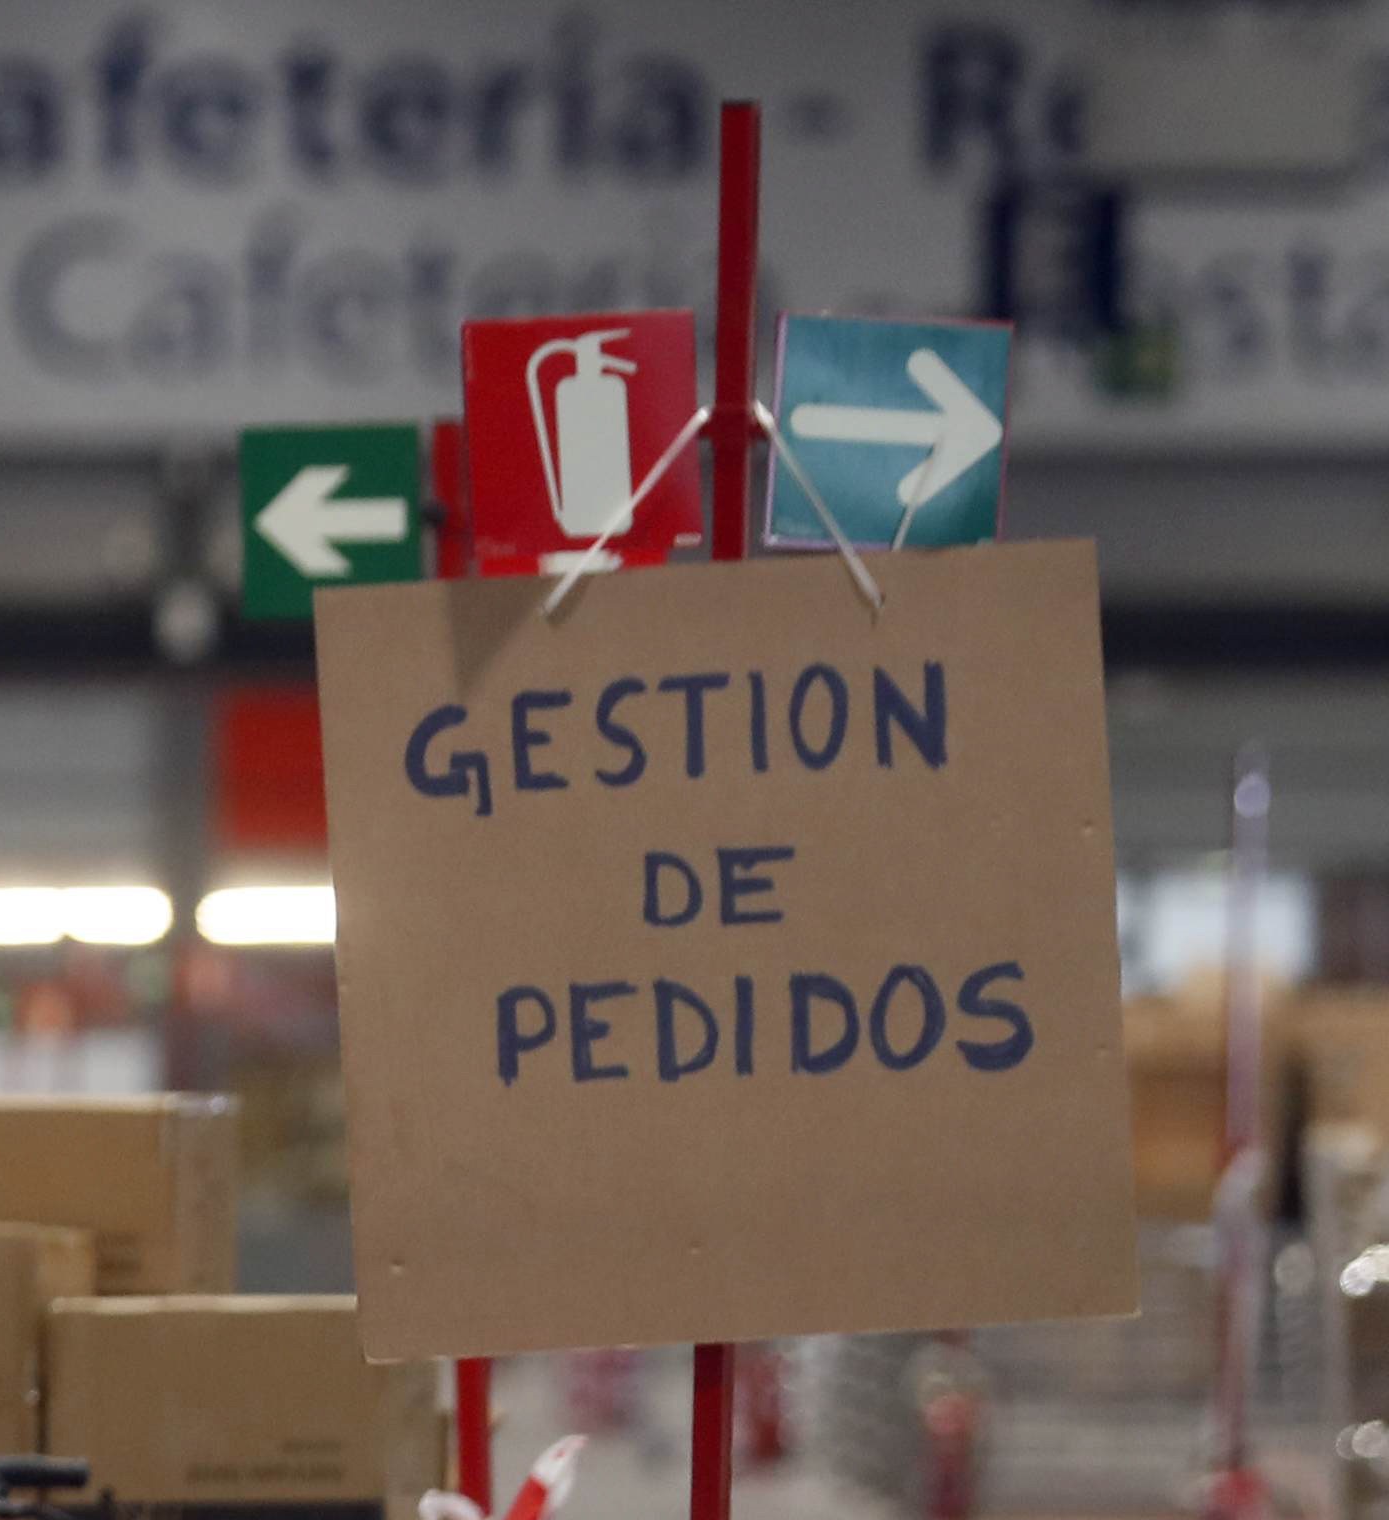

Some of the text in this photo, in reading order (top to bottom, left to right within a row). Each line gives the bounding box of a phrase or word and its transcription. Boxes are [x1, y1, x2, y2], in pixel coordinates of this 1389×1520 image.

[405, 661, 948, 816] GESTION
[642, 846, 796, 928] DE
[496, 960, 1036, 1087] PEDIDOS
